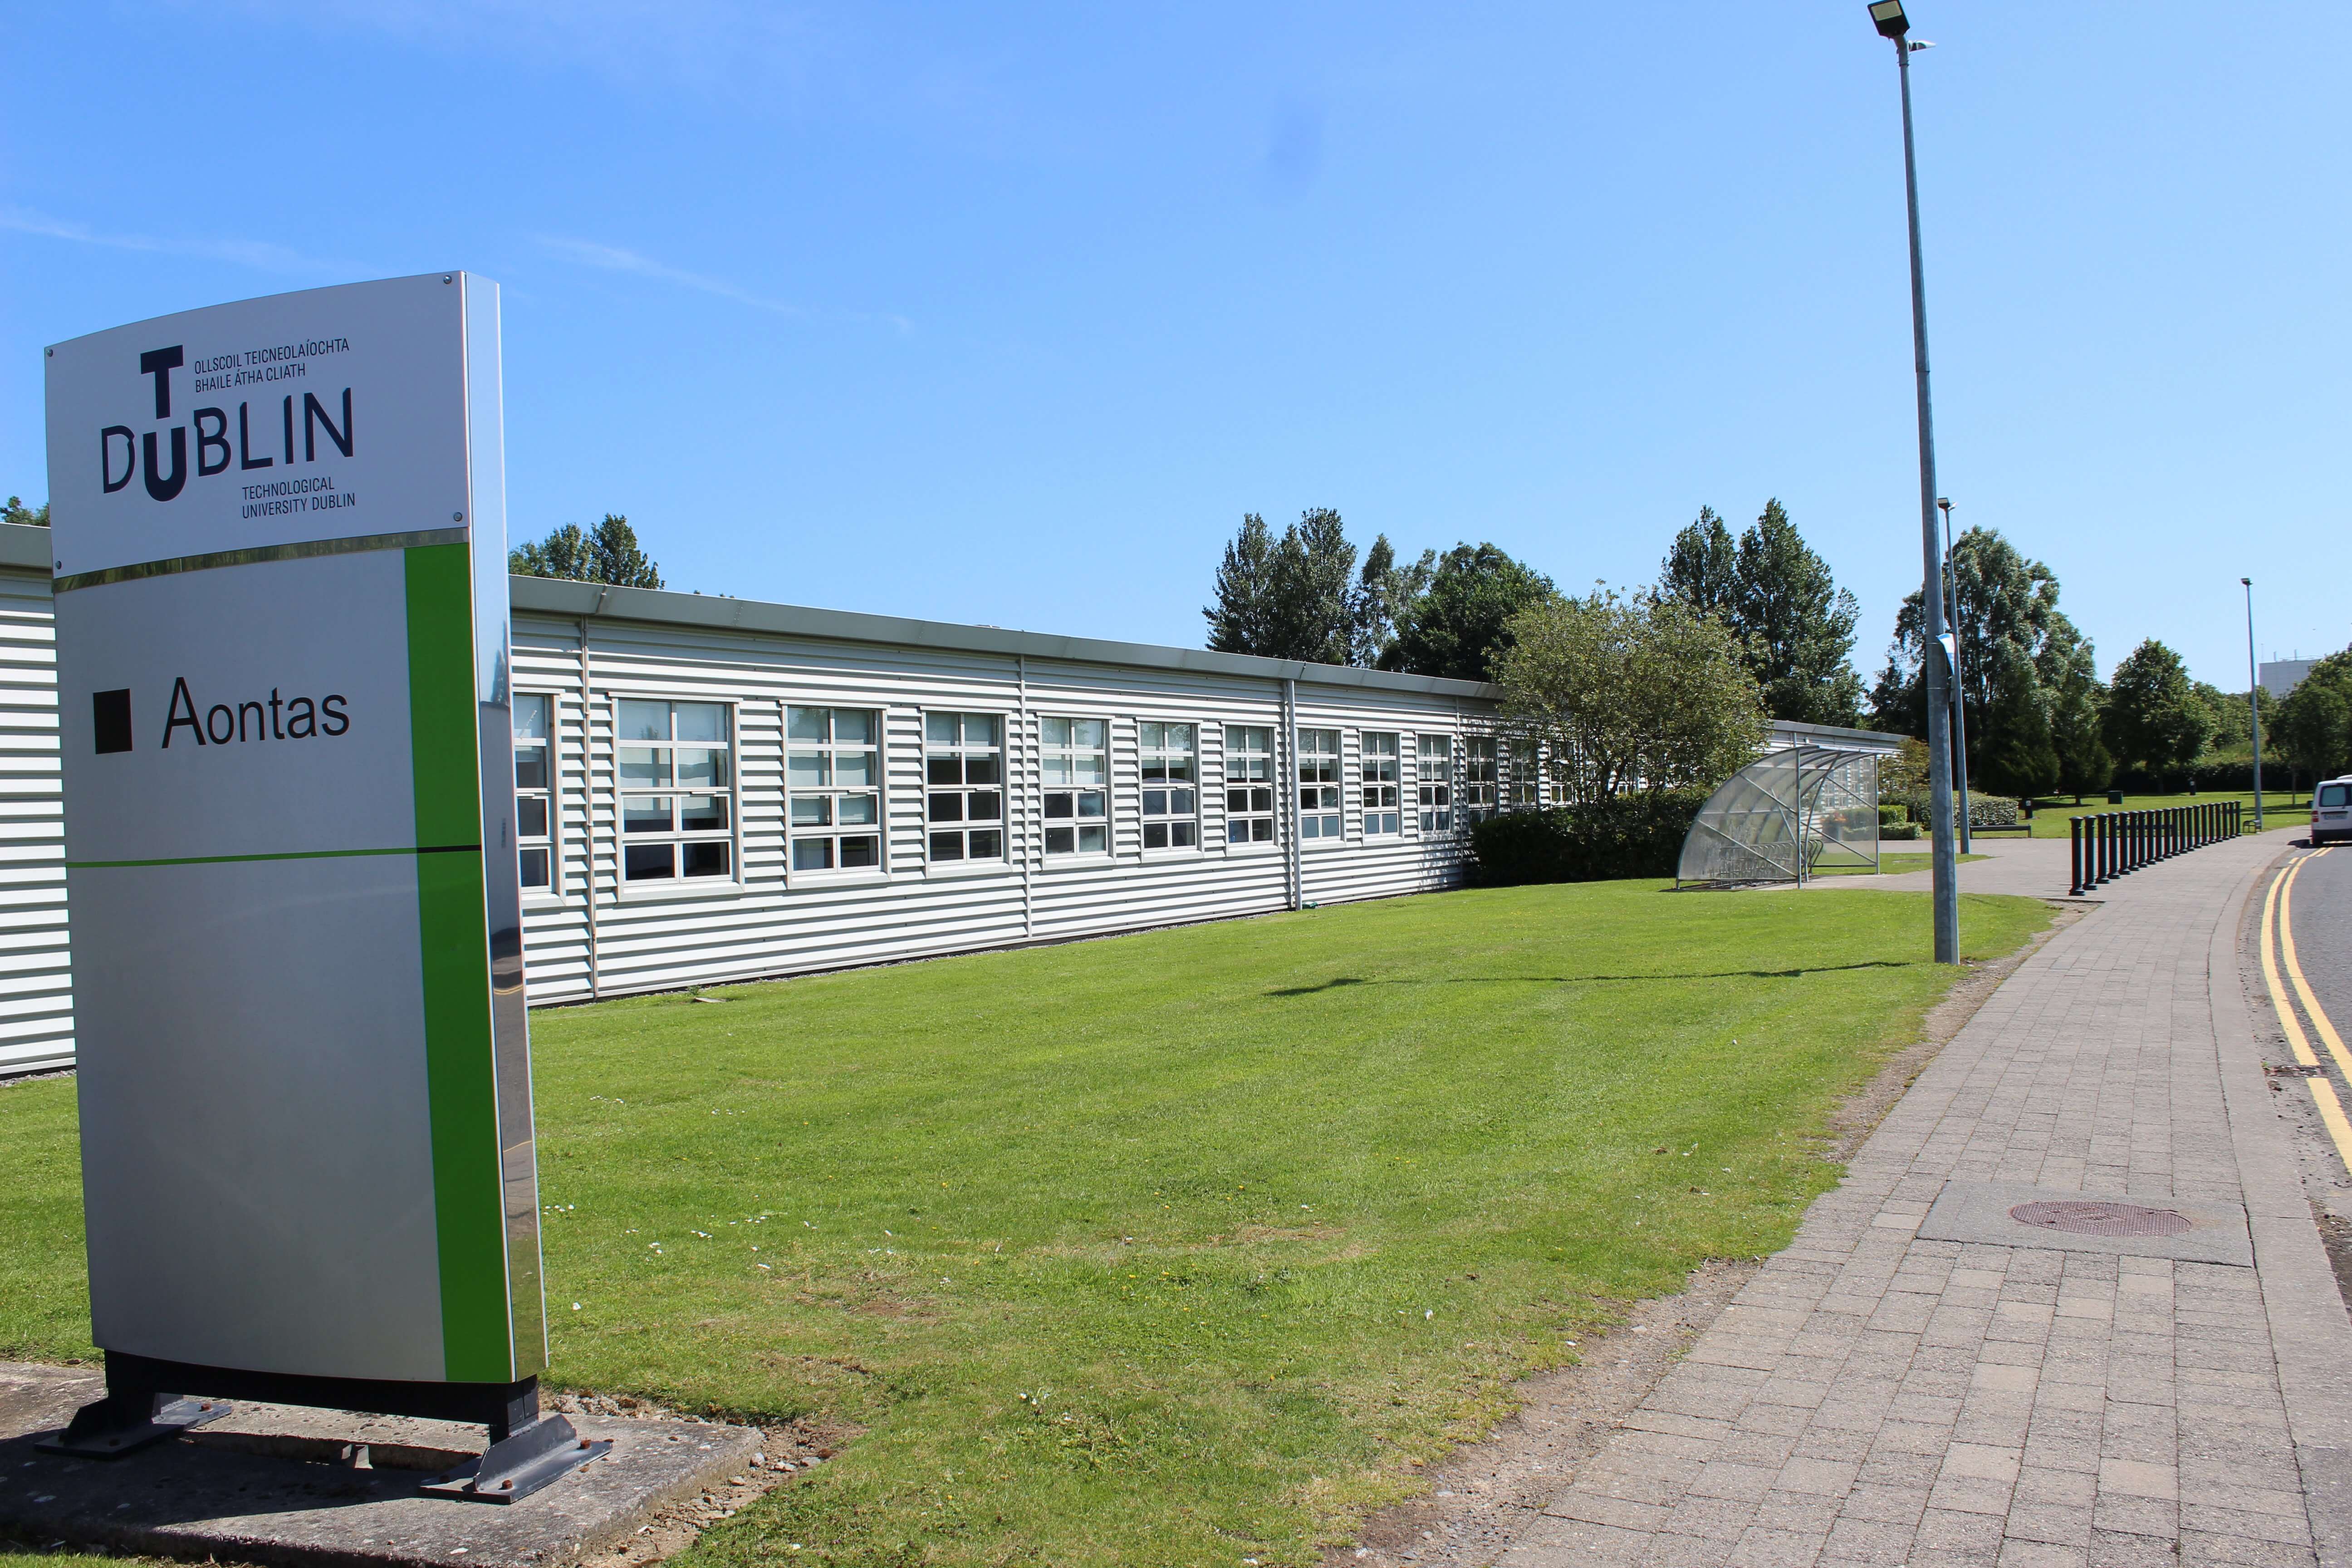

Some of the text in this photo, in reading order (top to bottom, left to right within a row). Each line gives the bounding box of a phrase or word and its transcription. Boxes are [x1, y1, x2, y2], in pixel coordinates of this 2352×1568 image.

[194, 338, 350, 375] OLLSCOIL TEICNEOLAÍOCHTA
[195, 363, 306, 393] BHAILE ÁTHA CLIATH
[101, 387, 354, 502] DUBLIN
[242, 476, 335, 501] TECHNOLOGICAL
[242, 492, 356, 519] UNIVERSITY DUBLIN
[161, 676, 350, 749] Aontas
